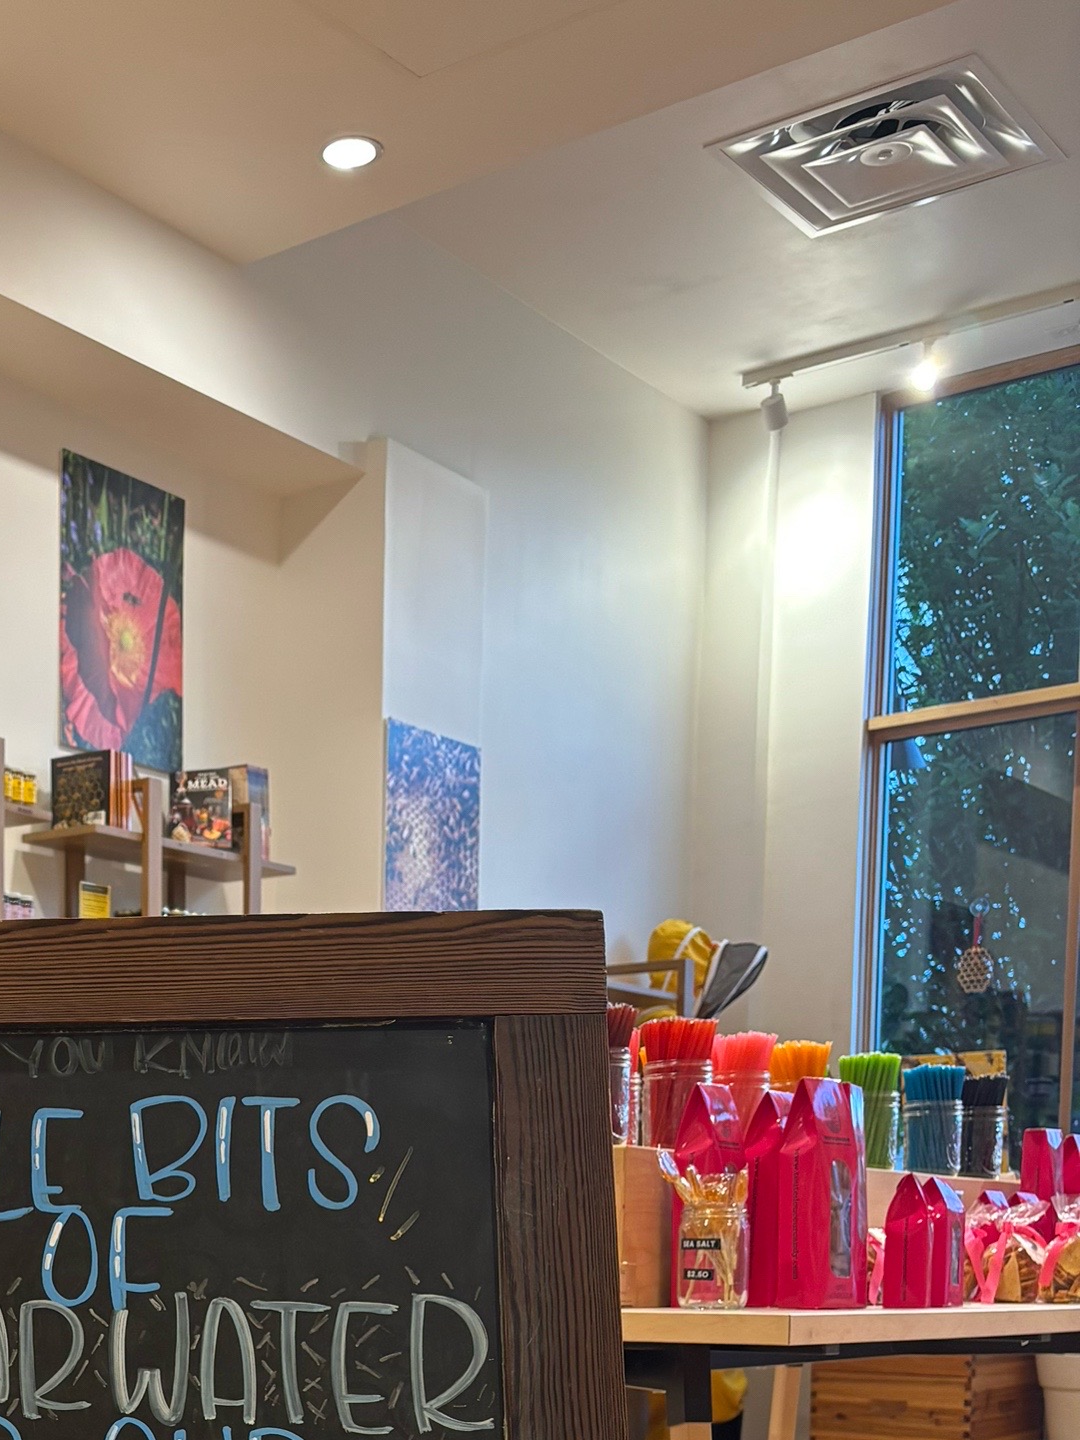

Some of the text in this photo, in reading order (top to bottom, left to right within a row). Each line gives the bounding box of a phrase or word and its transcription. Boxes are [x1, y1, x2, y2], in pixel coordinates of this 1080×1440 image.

[187, 778, 228, 790] MEAD
[1, 1036, 107, 1079] YOU
[130, 1095, 380, 1211] BITS
[40, 1205, 174, 1311] OF
[683, 1240, 716, 1248] SEA SALT
[109, 1291, 495, 1434] WATER
